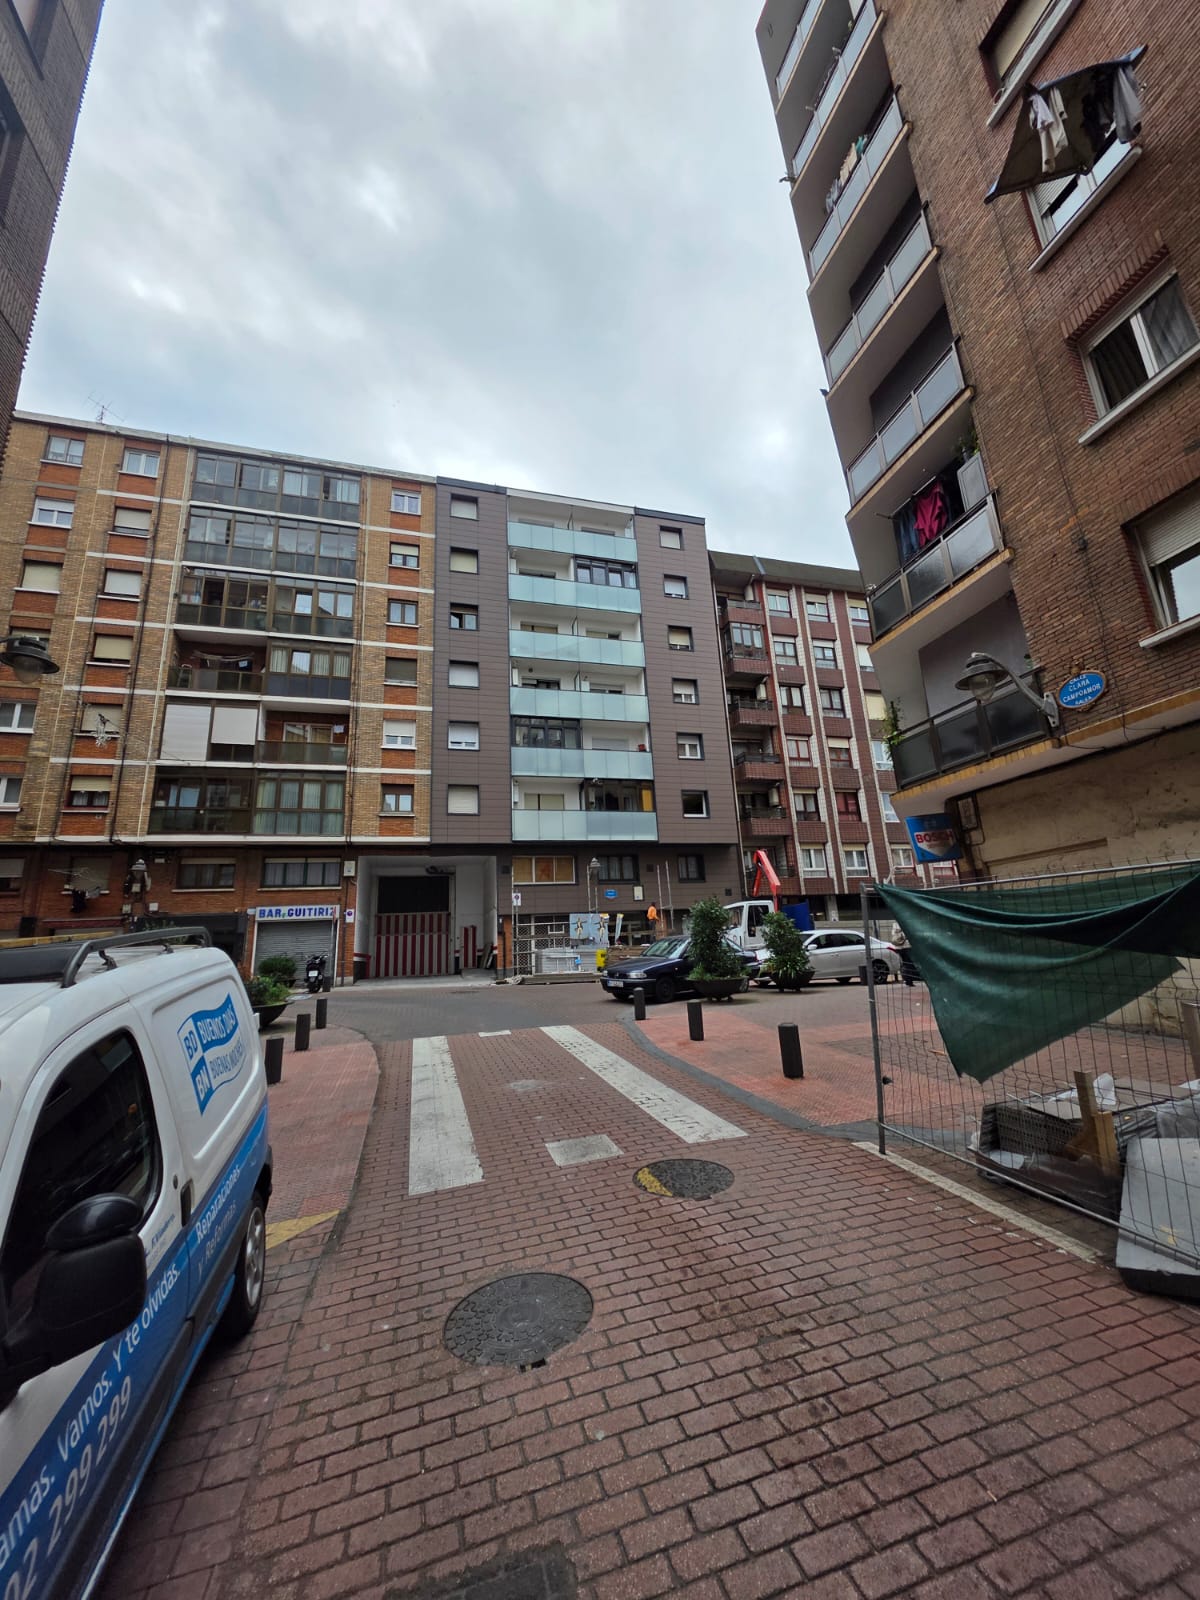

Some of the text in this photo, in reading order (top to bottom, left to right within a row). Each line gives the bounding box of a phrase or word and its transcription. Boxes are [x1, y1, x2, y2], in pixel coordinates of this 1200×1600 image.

[1062, 683, 1101, 702] CAMPOAMOR
[1069, 679, 1090, 691] CLARA
[258, 908, 282, 918] BAR
[183, 1030, 198, 1060] BD
[197, 1016, 226, 1044] BUENOS
[195, 1065, 211, 1101] BN
[195, 1164, 241, 1243] Reparaciones
[57, 1370, 112, 1462] Vamos.
[112, 1339, 122, 1373] Y
[125, 1323, 140, 1354] te
[141, 1263, 181, 1329] olvidas.
[46, 1444, 92, 1559] 299
[96, 1375, 132, 1466] 299
